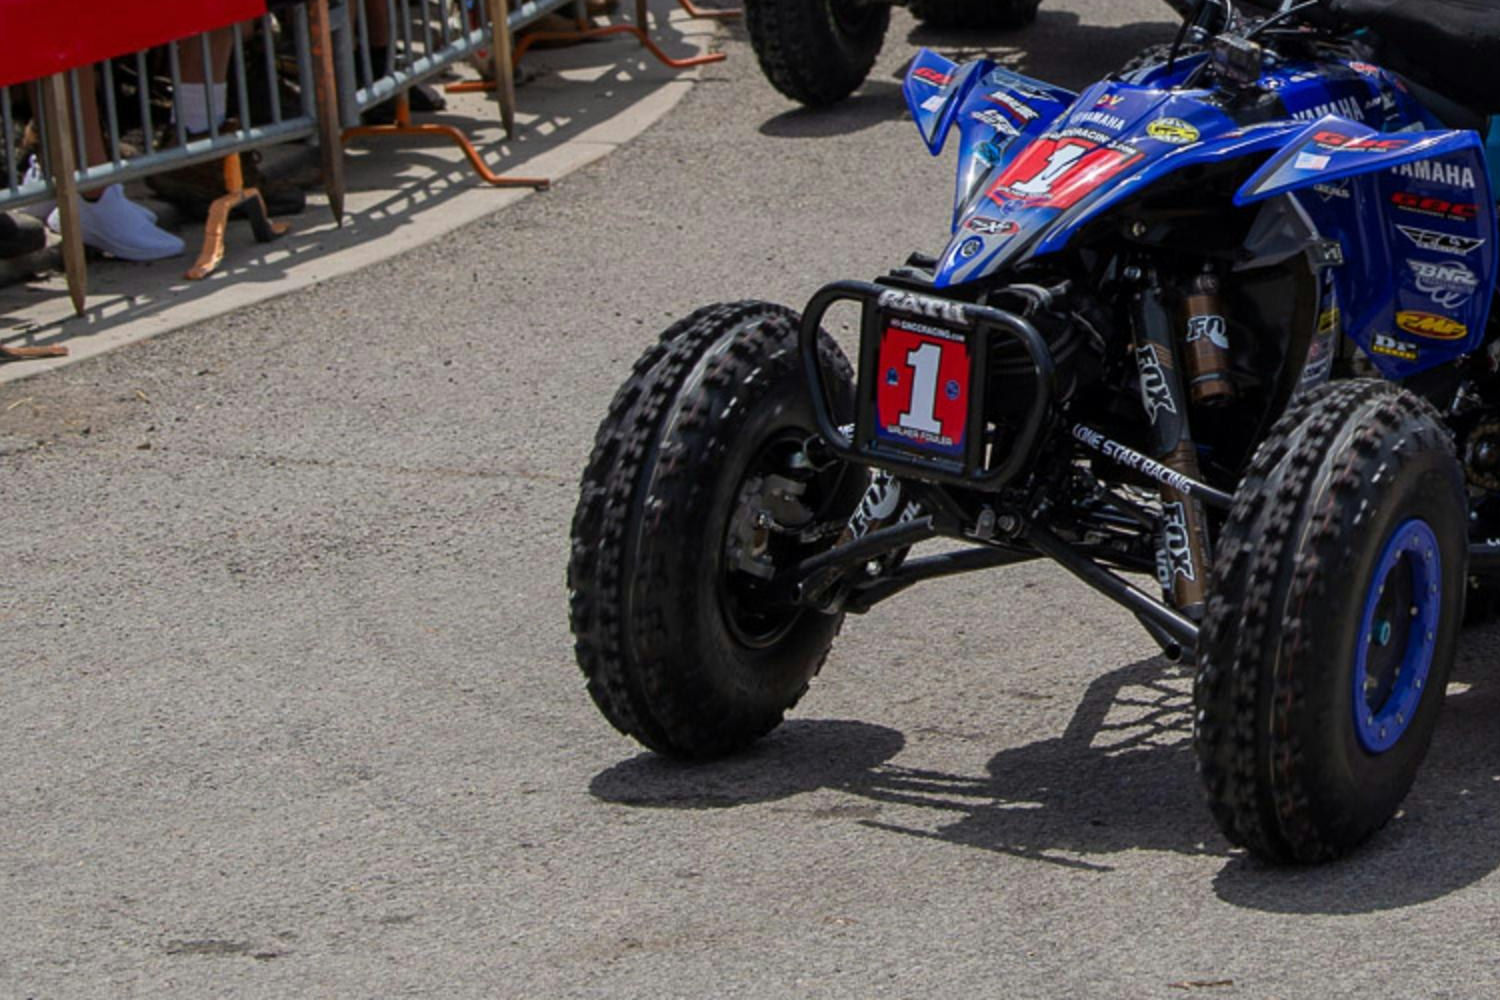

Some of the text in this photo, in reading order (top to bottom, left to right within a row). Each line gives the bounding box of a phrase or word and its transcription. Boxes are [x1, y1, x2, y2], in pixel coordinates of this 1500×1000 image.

[1293, 96, 1366, 121] YAMAHA
[1009, 142, 1089, 193] 1
[1391, 192, 1480, 217] GBC
[878, 288, 969, 325] RATH
[1397, 311, 1467, 338] FMF
[899, 342, 942, 435] 1
[1136, 343, 1178, 425] FOX
[1071, 423, 1192, 496] LONE STAR RACING
[1163, 500, 1196, 593] FOX
